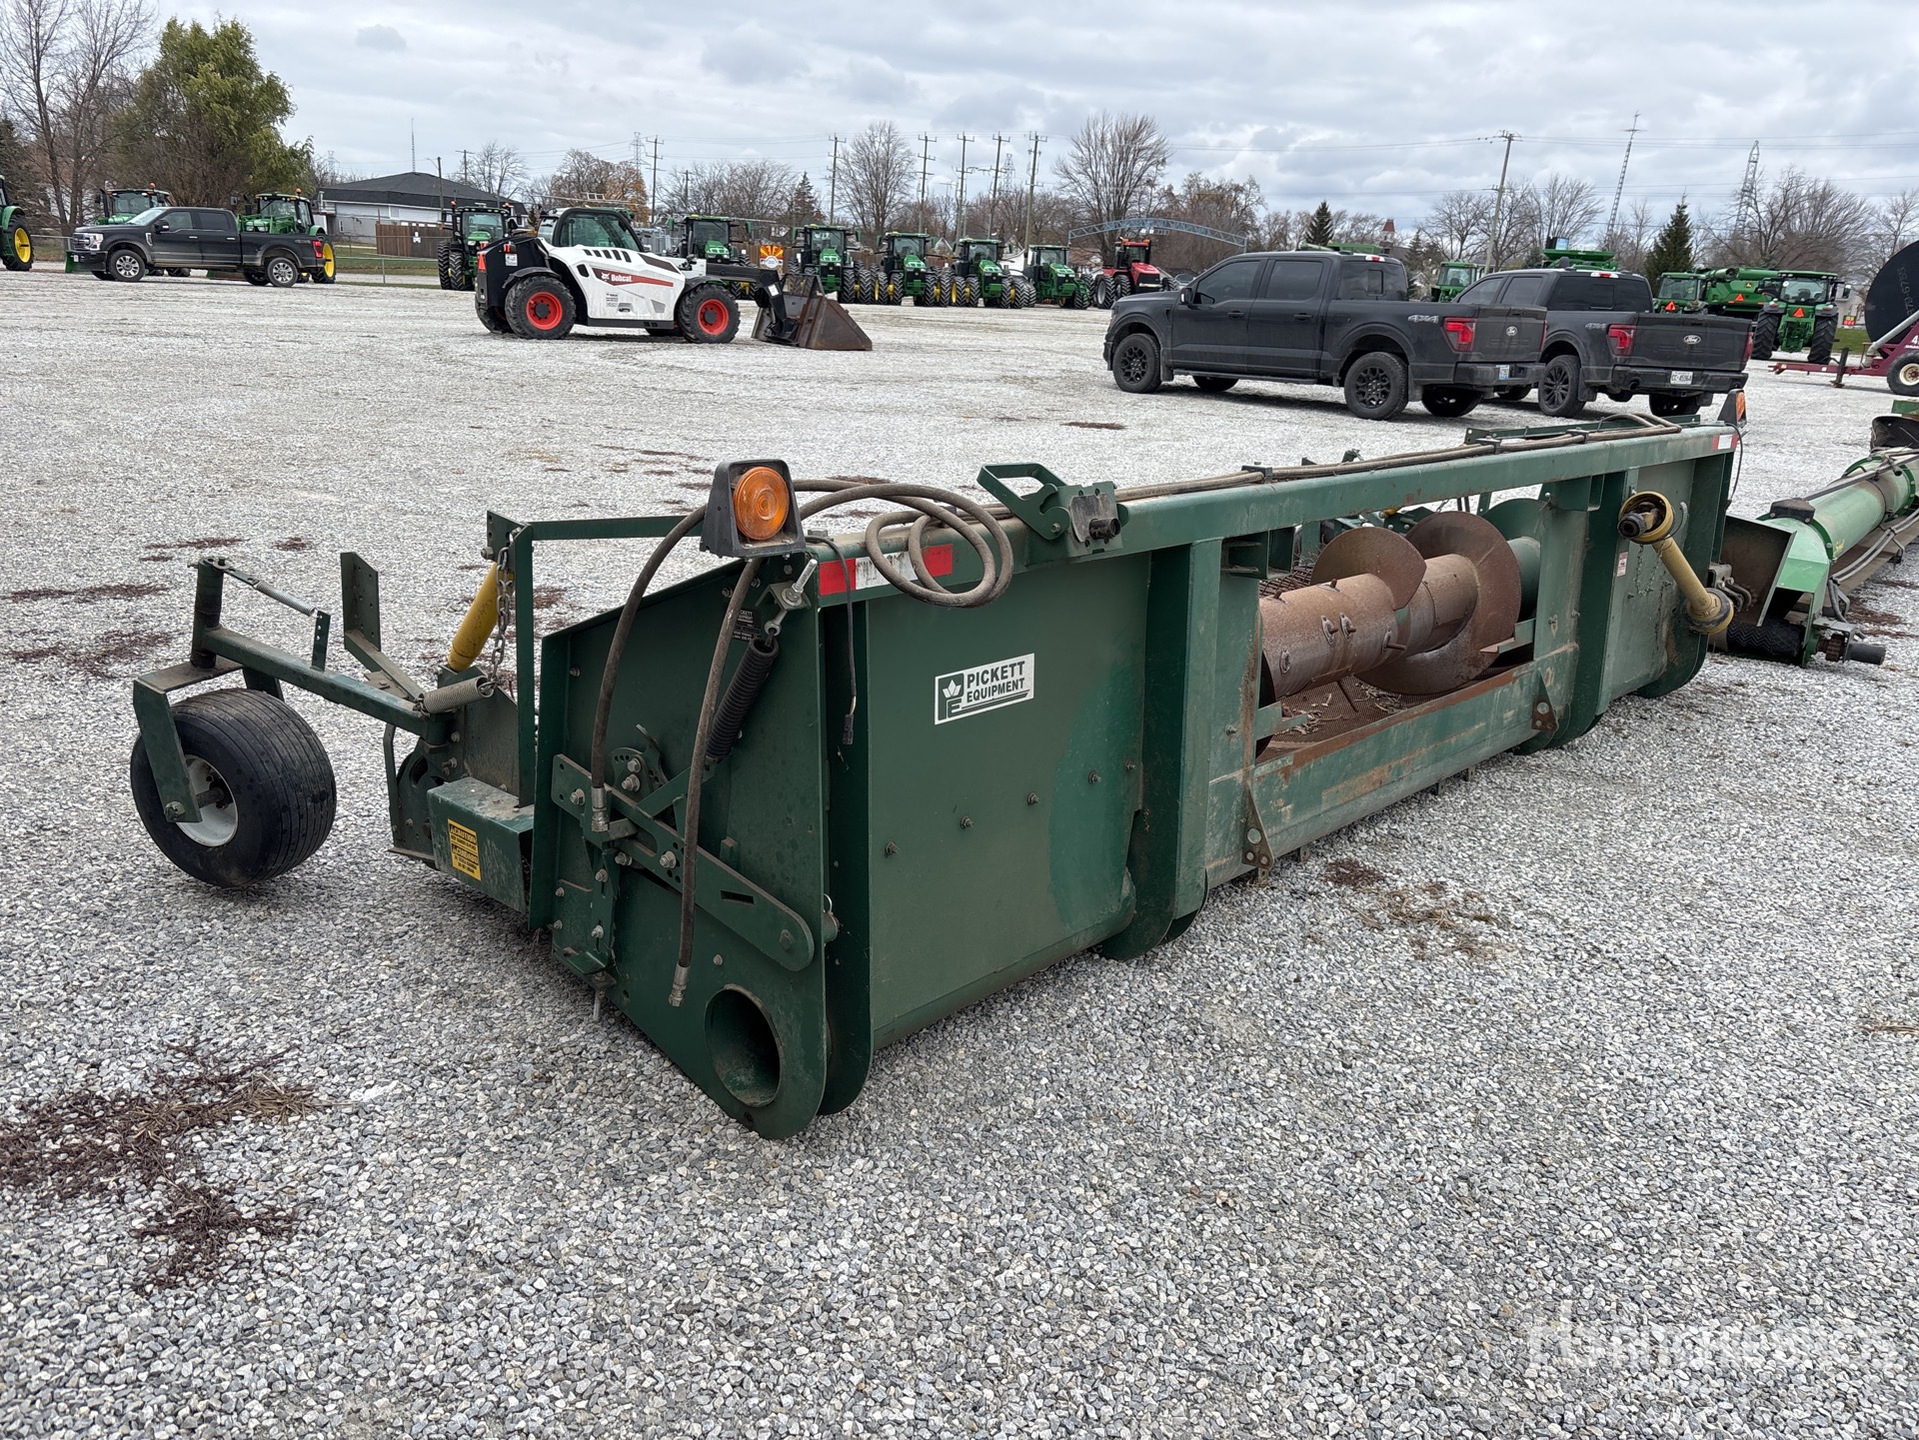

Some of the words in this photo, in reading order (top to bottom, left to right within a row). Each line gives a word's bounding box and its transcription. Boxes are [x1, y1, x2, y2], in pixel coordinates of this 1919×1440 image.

[611, 274, 632, 282] Bobcat
[967, 661, 1026, 689] PICKETT
[966, 677, 1026, 703] EQUIPMENT
